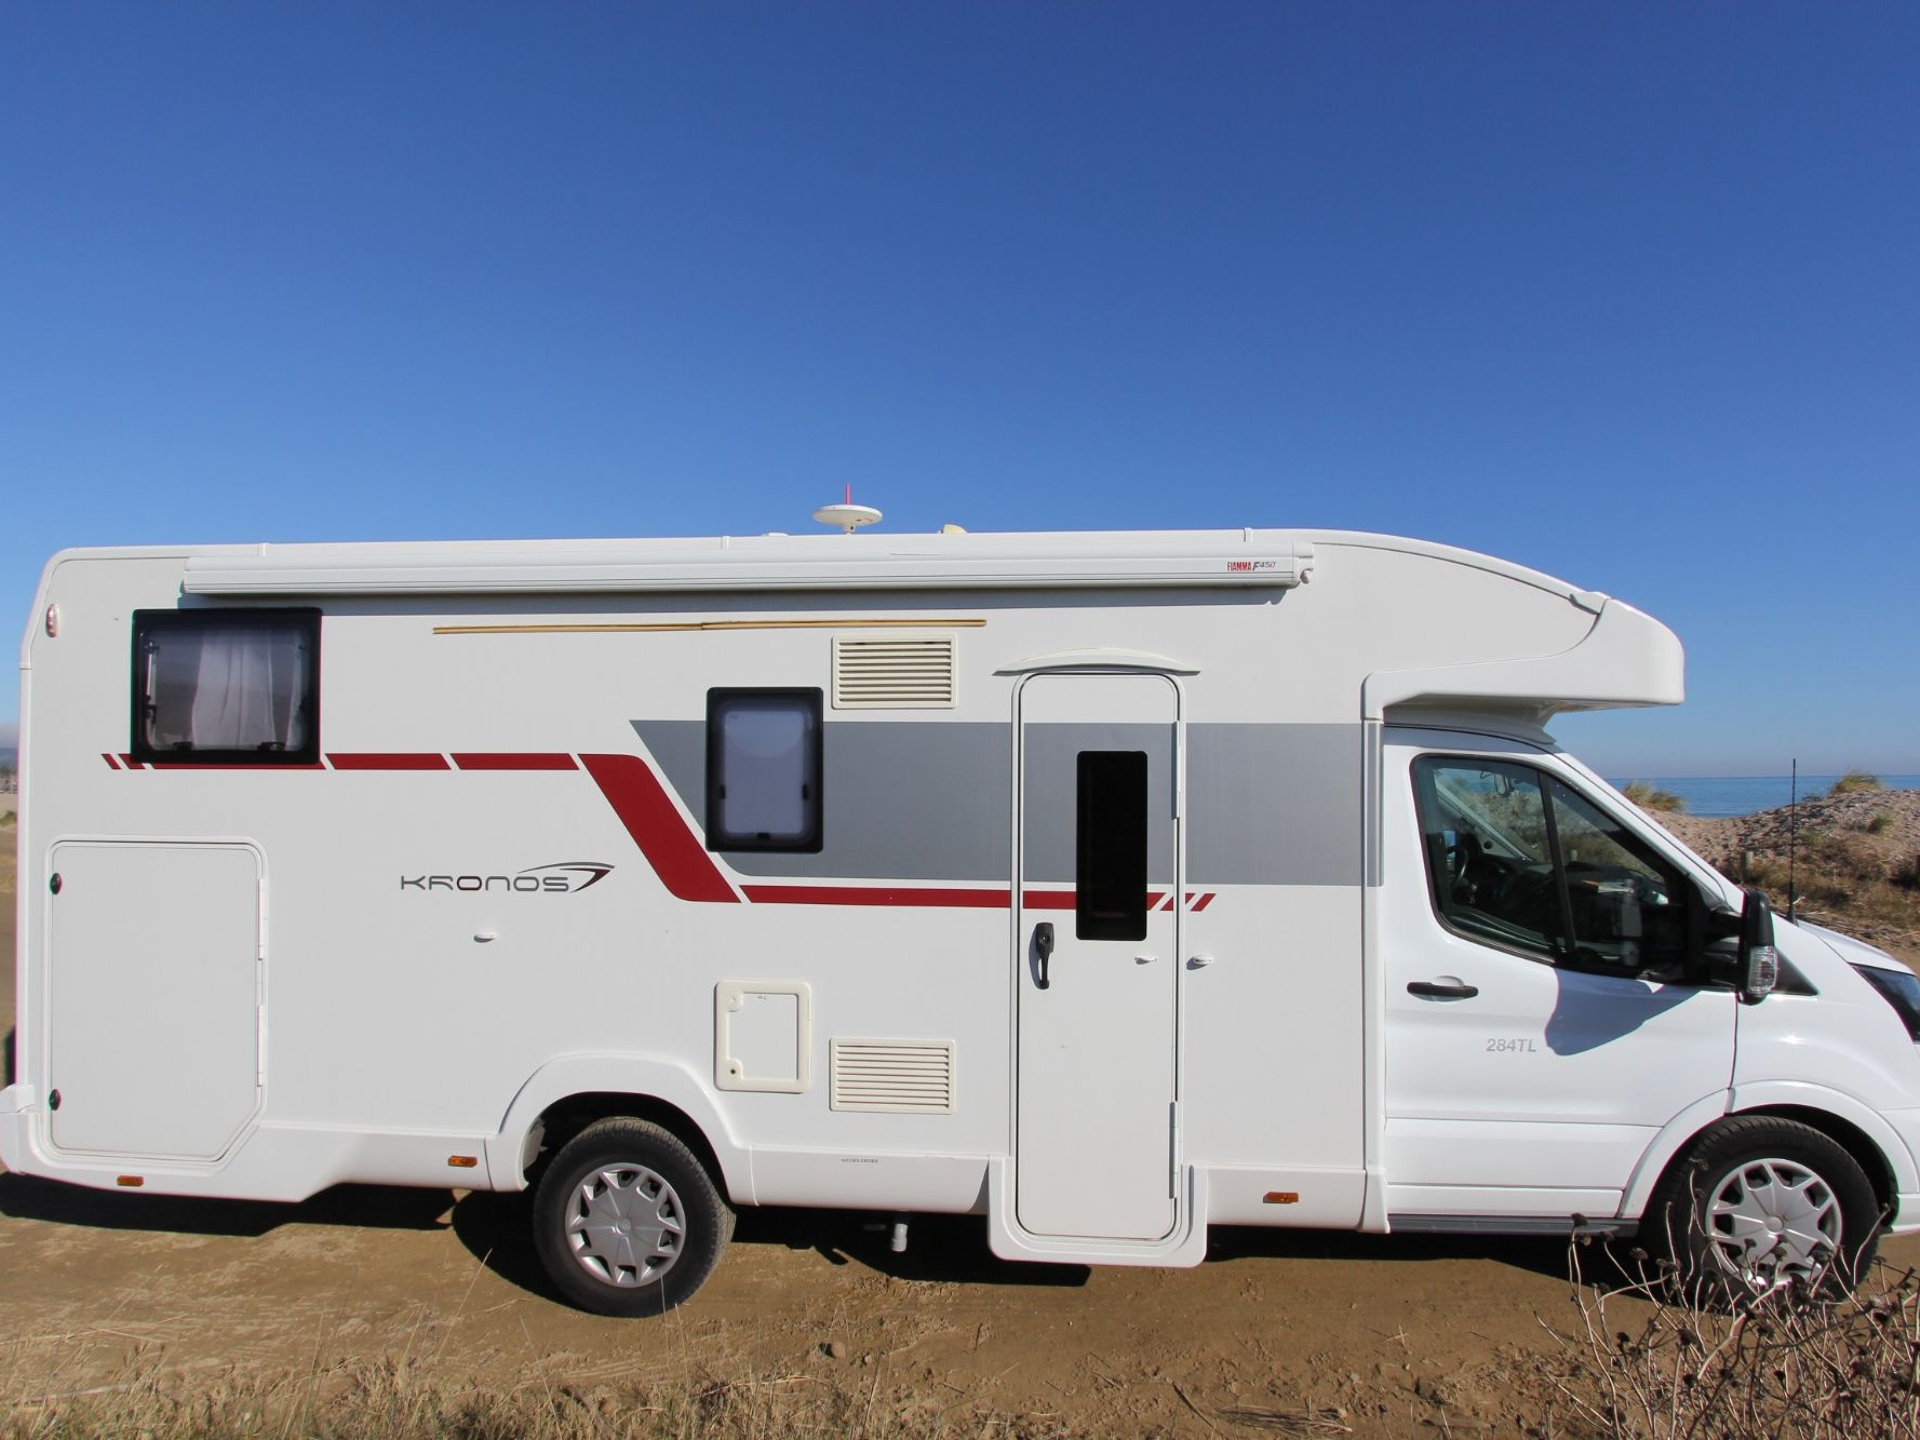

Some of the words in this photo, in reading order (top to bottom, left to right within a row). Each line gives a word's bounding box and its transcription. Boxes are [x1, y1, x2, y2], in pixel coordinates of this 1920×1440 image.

[1227, 561, 1252, 571] FIAMMA
[400, 875, 569, 892] KRONOS
[1486, 1038, 1537, 1053] 284TL
